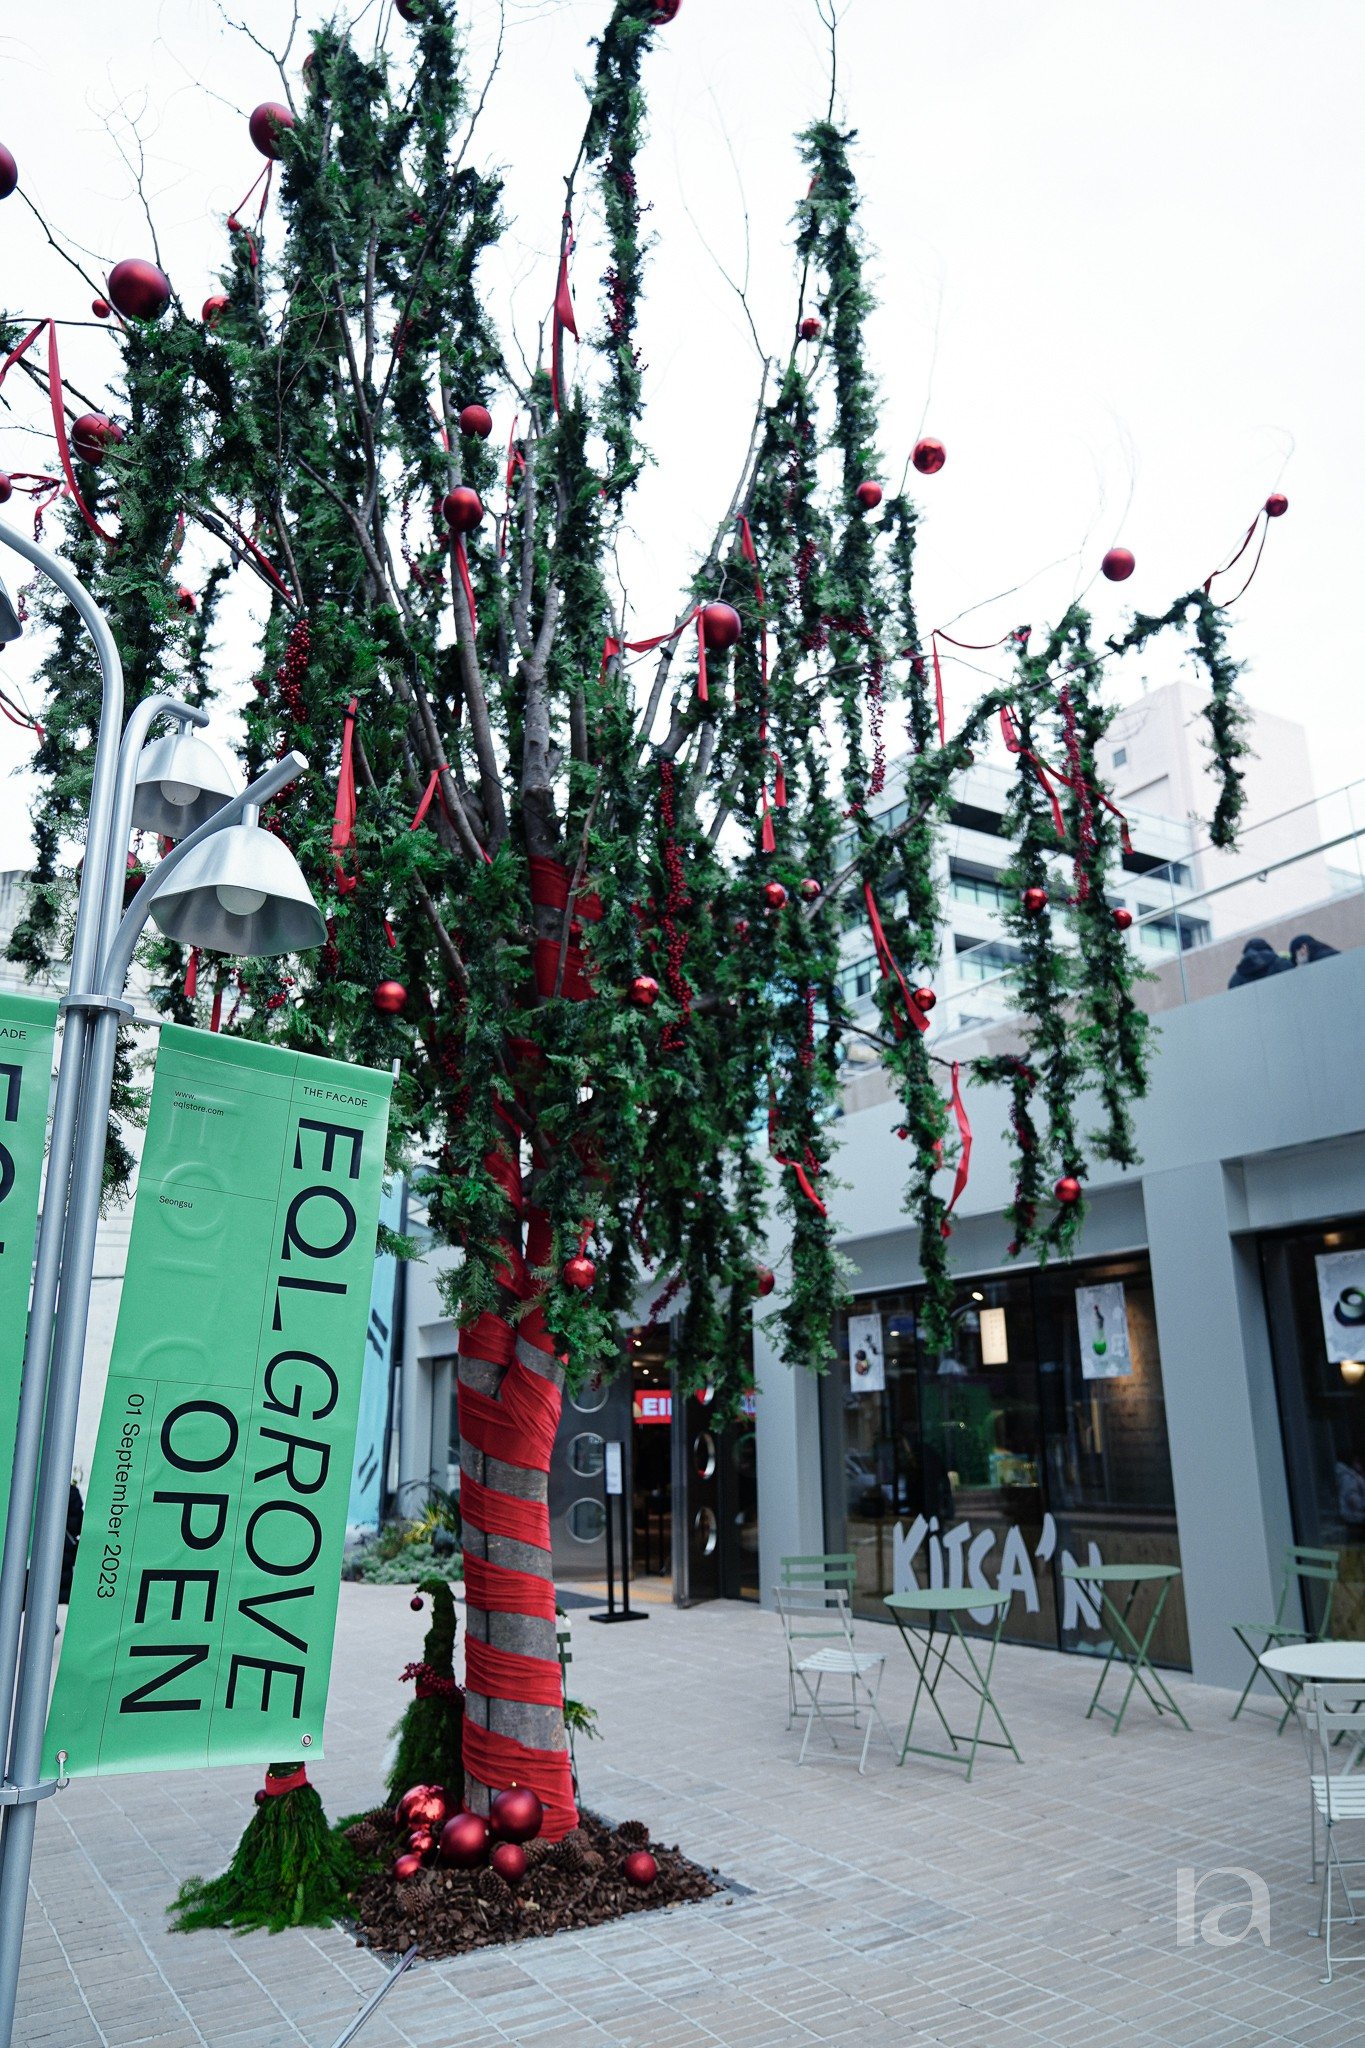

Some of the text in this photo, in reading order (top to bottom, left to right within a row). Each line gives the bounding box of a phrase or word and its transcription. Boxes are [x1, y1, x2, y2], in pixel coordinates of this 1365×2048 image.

[174, 1090, 197, 1101] www.
[303, 1086, 369, 1109] THE FACADE
[173, 1100, 225, 1117] eqlstore.com
[158, 1194, 194, 1210] Seongsu
[96, 1393, 145, 1599] 01 September 2023
[120, 1399, 239, 1714] OPEN
